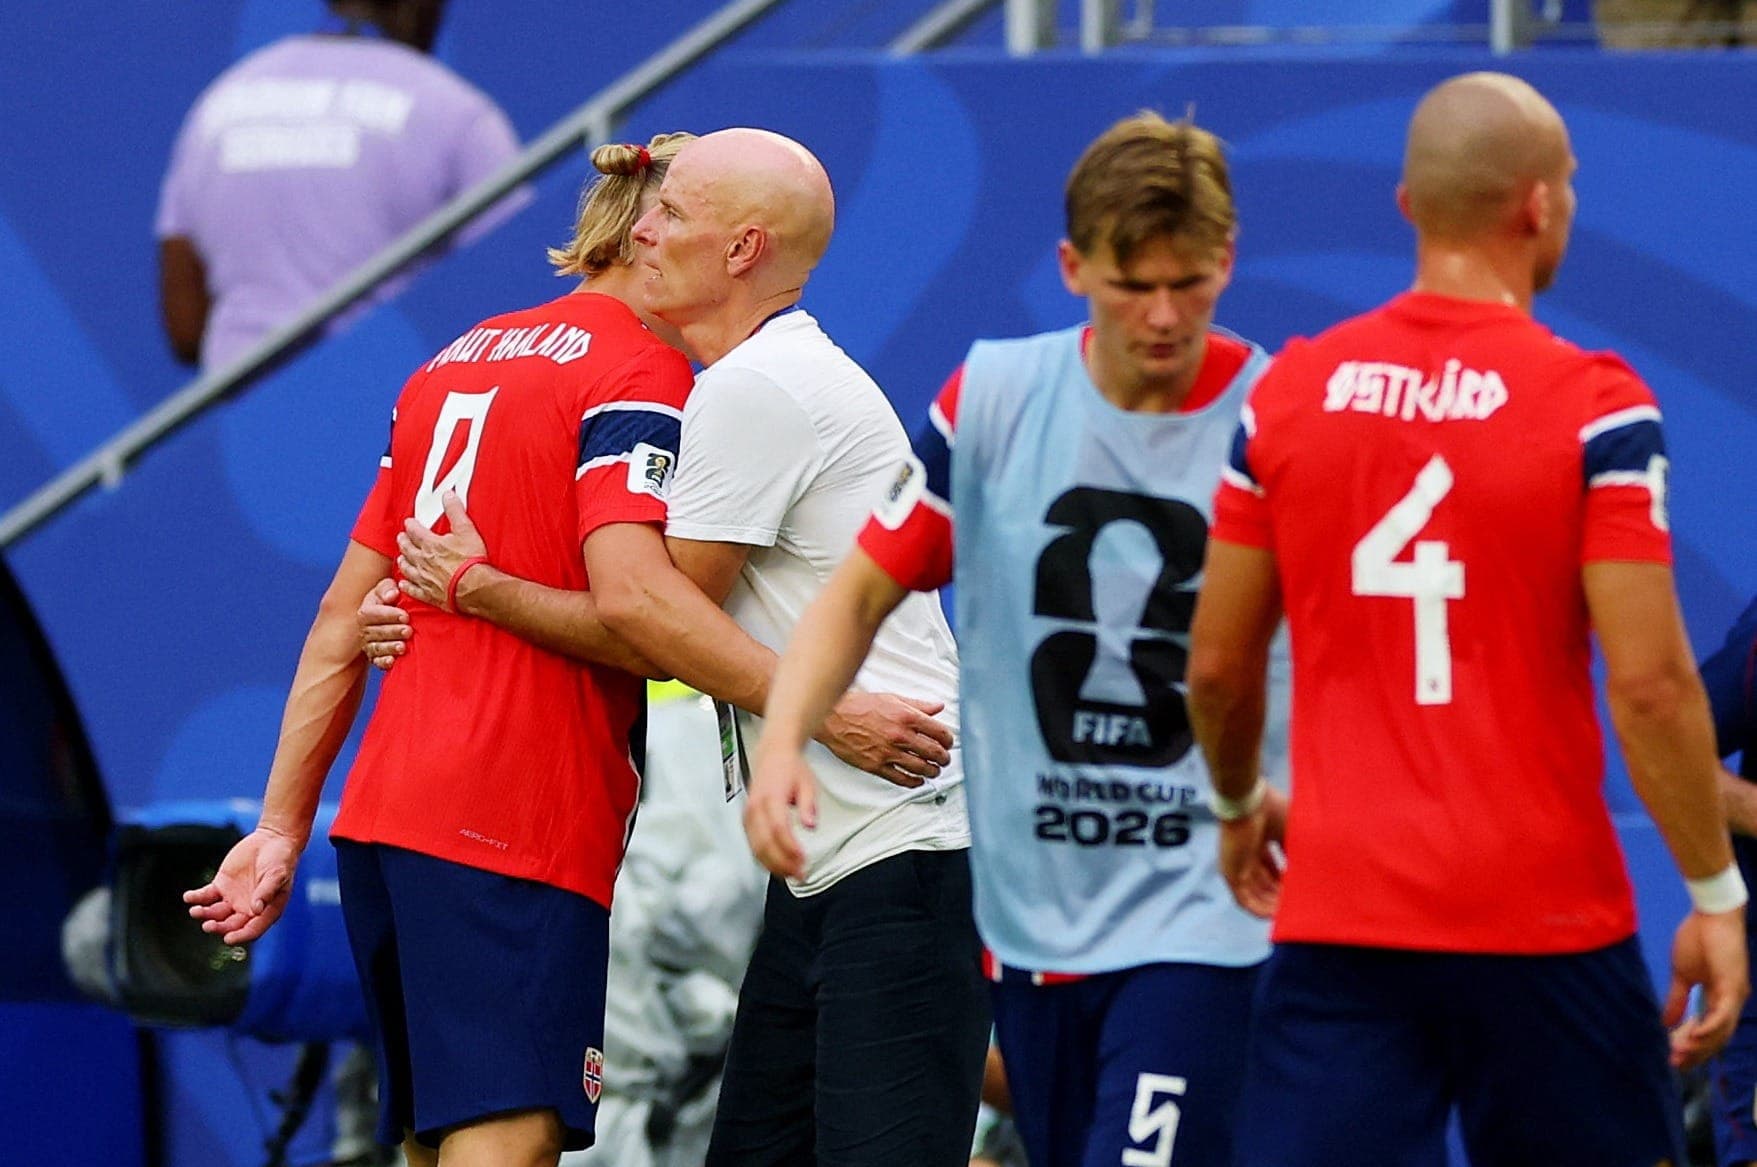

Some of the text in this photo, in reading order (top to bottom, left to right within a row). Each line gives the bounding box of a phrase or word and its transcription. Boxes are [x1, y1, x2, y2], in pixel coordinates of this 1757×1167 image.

[486, 323, 592, 365] HAALAND
[1351, 452, 1466, 705] 4
[1072, 711, 1152, 747] FIFA
[1036, 773, 1197, 805] WORLD CUP
[1034, 805, 1193, 848] 2026
[1121, 1072, 1187, 1167] 5
